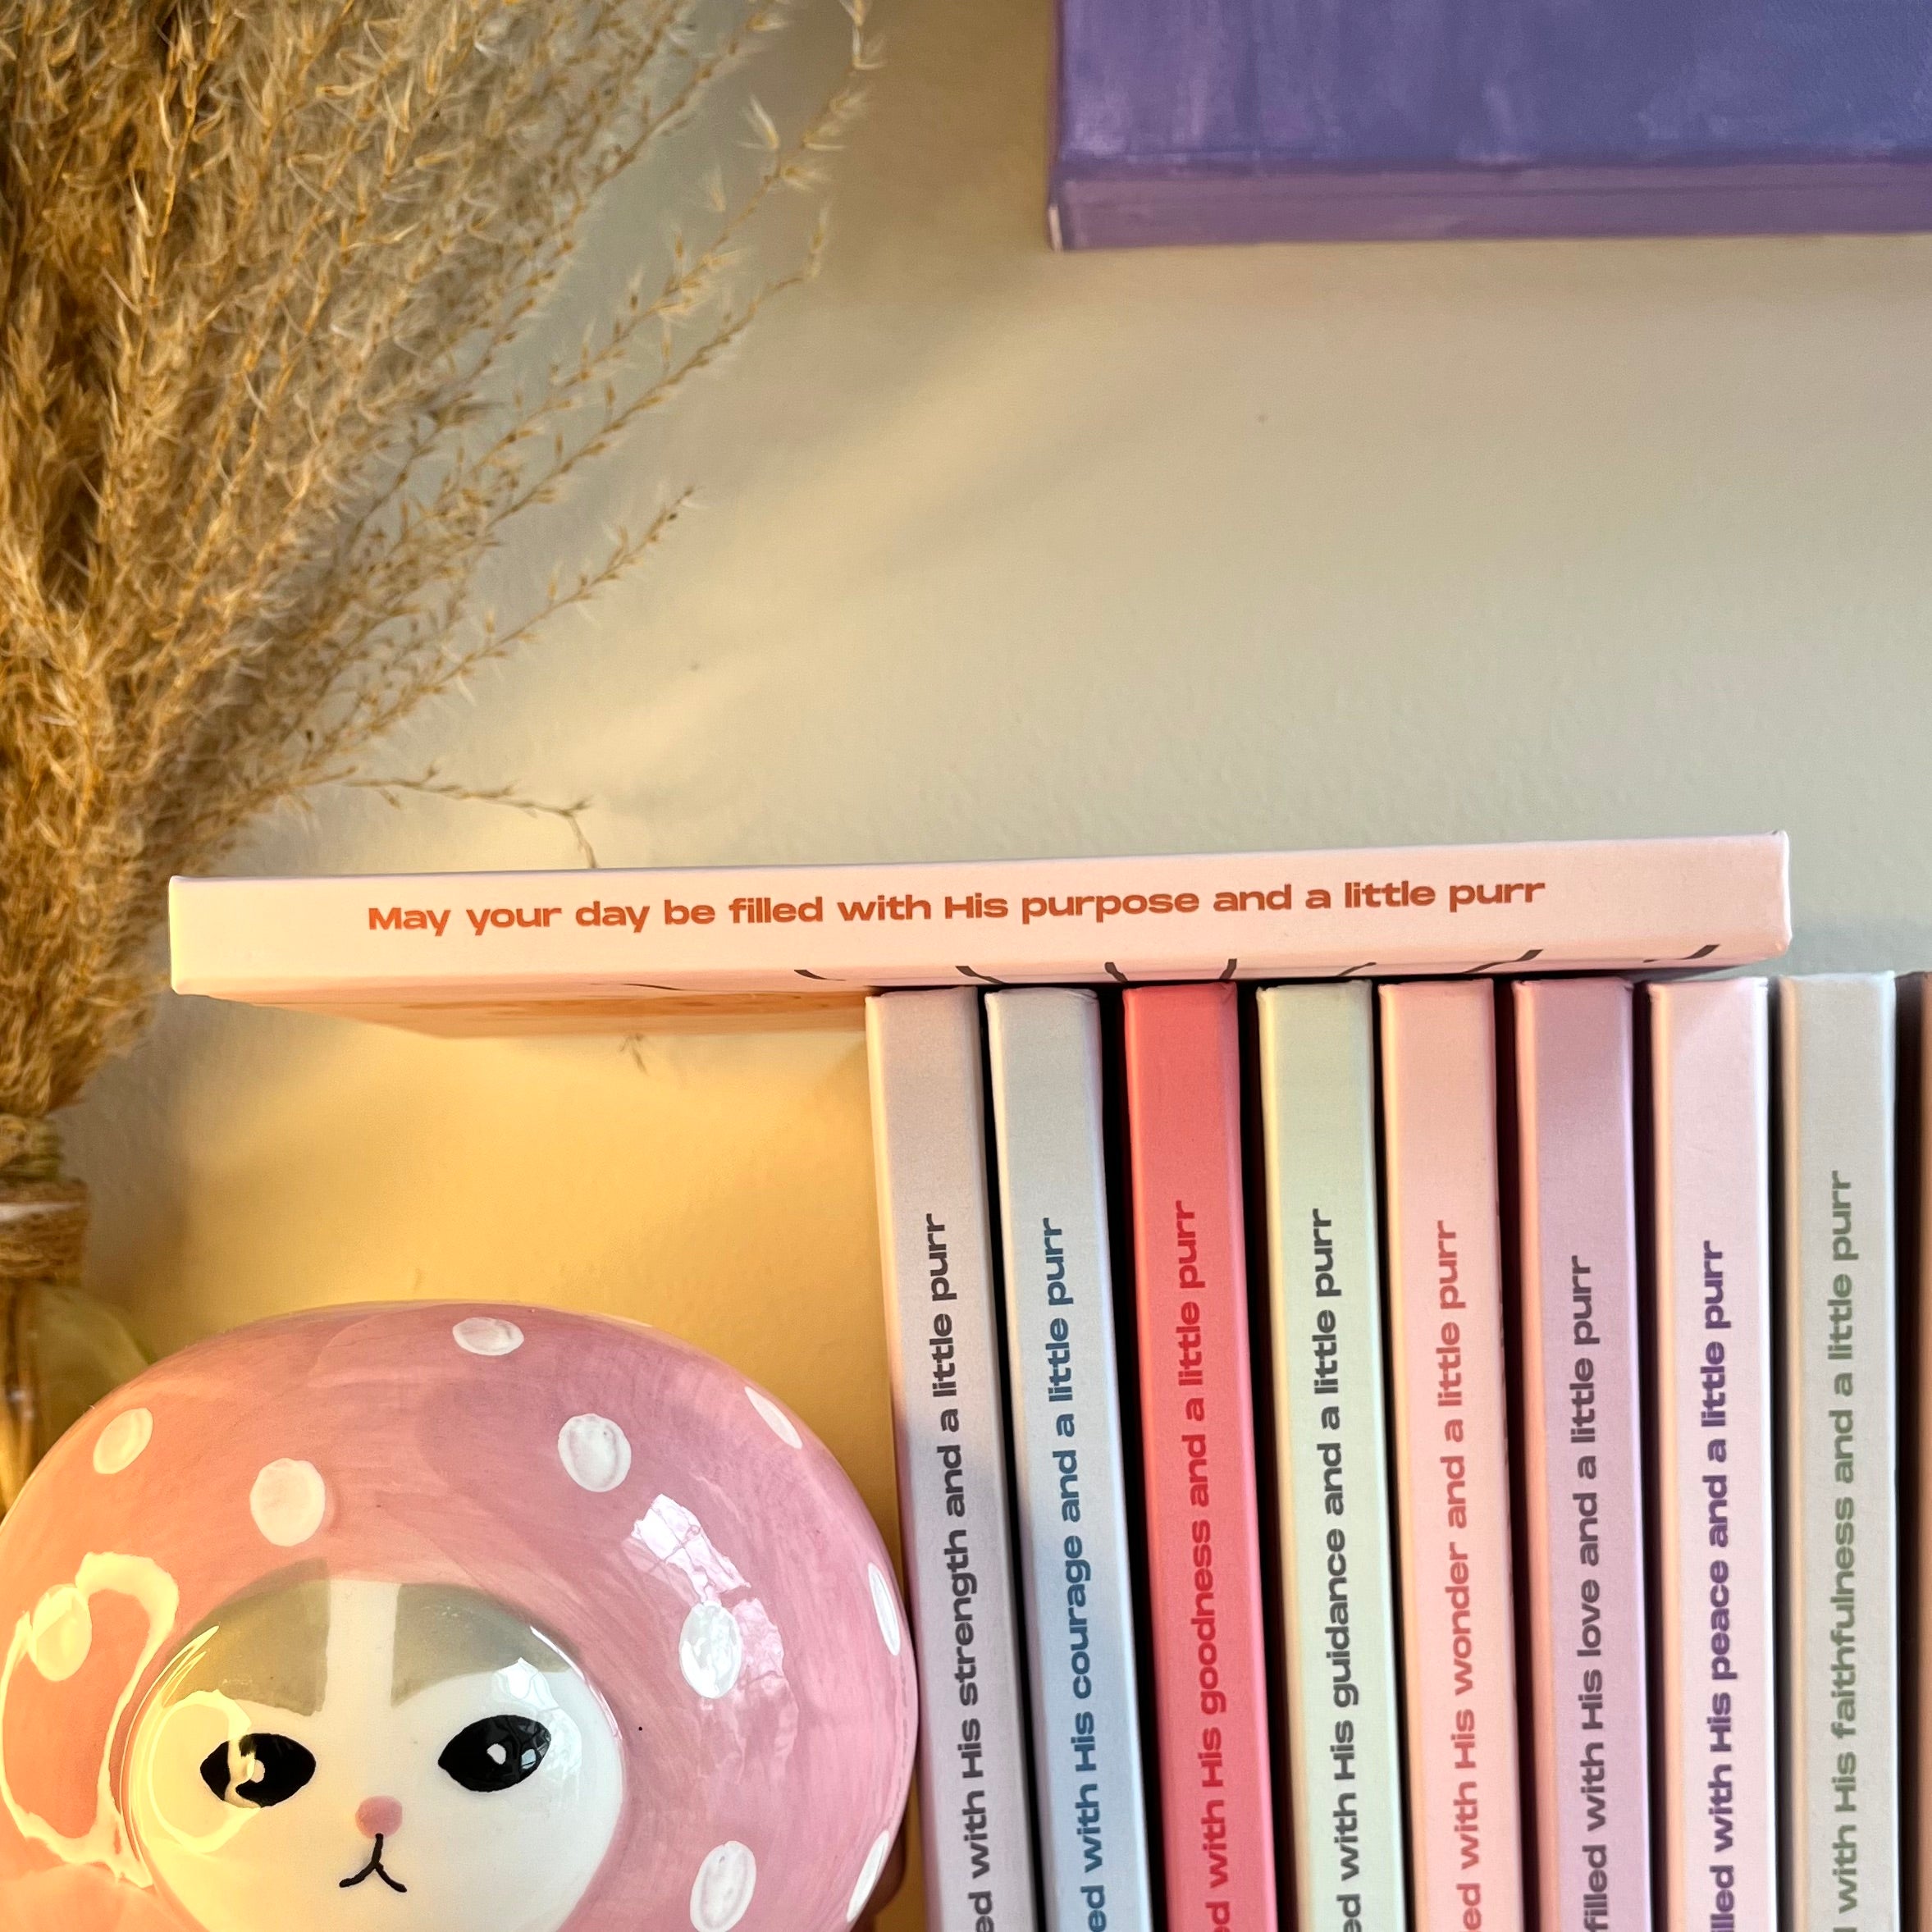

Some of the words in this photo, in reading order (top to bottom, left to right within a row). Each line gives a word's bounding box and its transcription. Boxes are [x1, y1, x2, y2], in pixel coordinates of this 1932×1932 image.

[369, 907, 450, 936] May
[466, 908, 562, 936] your
[576, 901, 650, 933] day
[665, 899, 715, 925] be
[728, 897, 823, 924] filled
[837, 894, 931, 921] with
[945, 893, 1008, 919] His
[1022, 893, 1199, 925] purpose
[1213, 884, 1291, 911] and
[1305, 889, 1331, 909] a
[1345, 880, 1436, 908] little
[1450, 883, 1545, 912] purr
[926, 1213, 957, 1301] purr
[1176, 1200, 1205, 1289] purr
[1313, 1208, 1341, 1297] purr
[1832, 1171, 1859, 1261] purr
[1043, 1217, 1074, 1305] purr
[1437, 1221, 1466, 1309] purr
[1572, 1255, 1600, 1345] purr
[1704, 1240, 1732, 1329] purr
[929, 1313, 957, 1397] little
[1176, 1302, 1203, 1386] little
[1312, 1310, 1338, 1394] little
[1828, 1274, 1852, 1359] little
[1045, 1318, 1072, 1402] little
[1436, 1322, 1462, 1406] little
[1569, 1358, 1595, 1443] little
[1700, 1341, 1726, 1427] little
[1834, 1372, 1853, 1396] a
[941, 1409, 959, 1432] a
[1056, 1414, 1075, 1437] a
[1185, 1398, 1204, 1421] a
[1322, 1406, 1340, 1430] a
[1445, 1419, 1464, 1442] a
[1707, 1439, 1727, 1463] a
[1829, 1409, 1854, 1483] and
[937, 1445, 965, 1517] and
[1053, 1450, 1080, 1522] and
[1181, 1434, 1209, 1507] and
[1317, 1443, 1344, 1515] and
[1440, 1456, 1467, 1528] and
[1578, 1456, 1596, 1479] a
[1573, 1492, 1599, 1566] and
[1702, 1475, 1729, 1547] and
[944, 1530, 978, 1706] strength
[1064, 1536, 1091, 1699] courage
[1190, 1519, 1226, 1715] goodness
[1325, 1529, 1359, 1707] guidance
[1445, 1542, 1473, 1696] wonder
[1577, 1579, 1601, 1656] love
[1710, 1560, 1738, 1680] peace
[1830, 1497, 1856, 1739] faithfulness
[1071, 1711, 1096, 1771] His
[1450, 1709, 1476, 1769] His
[1578, 1669, 1603, 1729] His
[1707, 1692, 1732, 1752] His
[957, 1719, 983, 1778] His
[1198, 1728, 1223, 1788] His
[1330, 1720, 1355, 1780] His
[1580, 1742, 1605, 1831] with
[1831, 1752, 1857, 1812] His
[962, 1791, 989, 1879] with
[1076, 1784, 1103, 1873] with
[1201, 1800, 1228, 1889] with
[1333, 1793, 1359, 1881] with
[1453, 1782, 1479, 1870] with
[1708, 1765, 1733, 1852] with
[1583, 1845, 1608, 1932] filled
[1832, 1825, 1857, 1914] with
